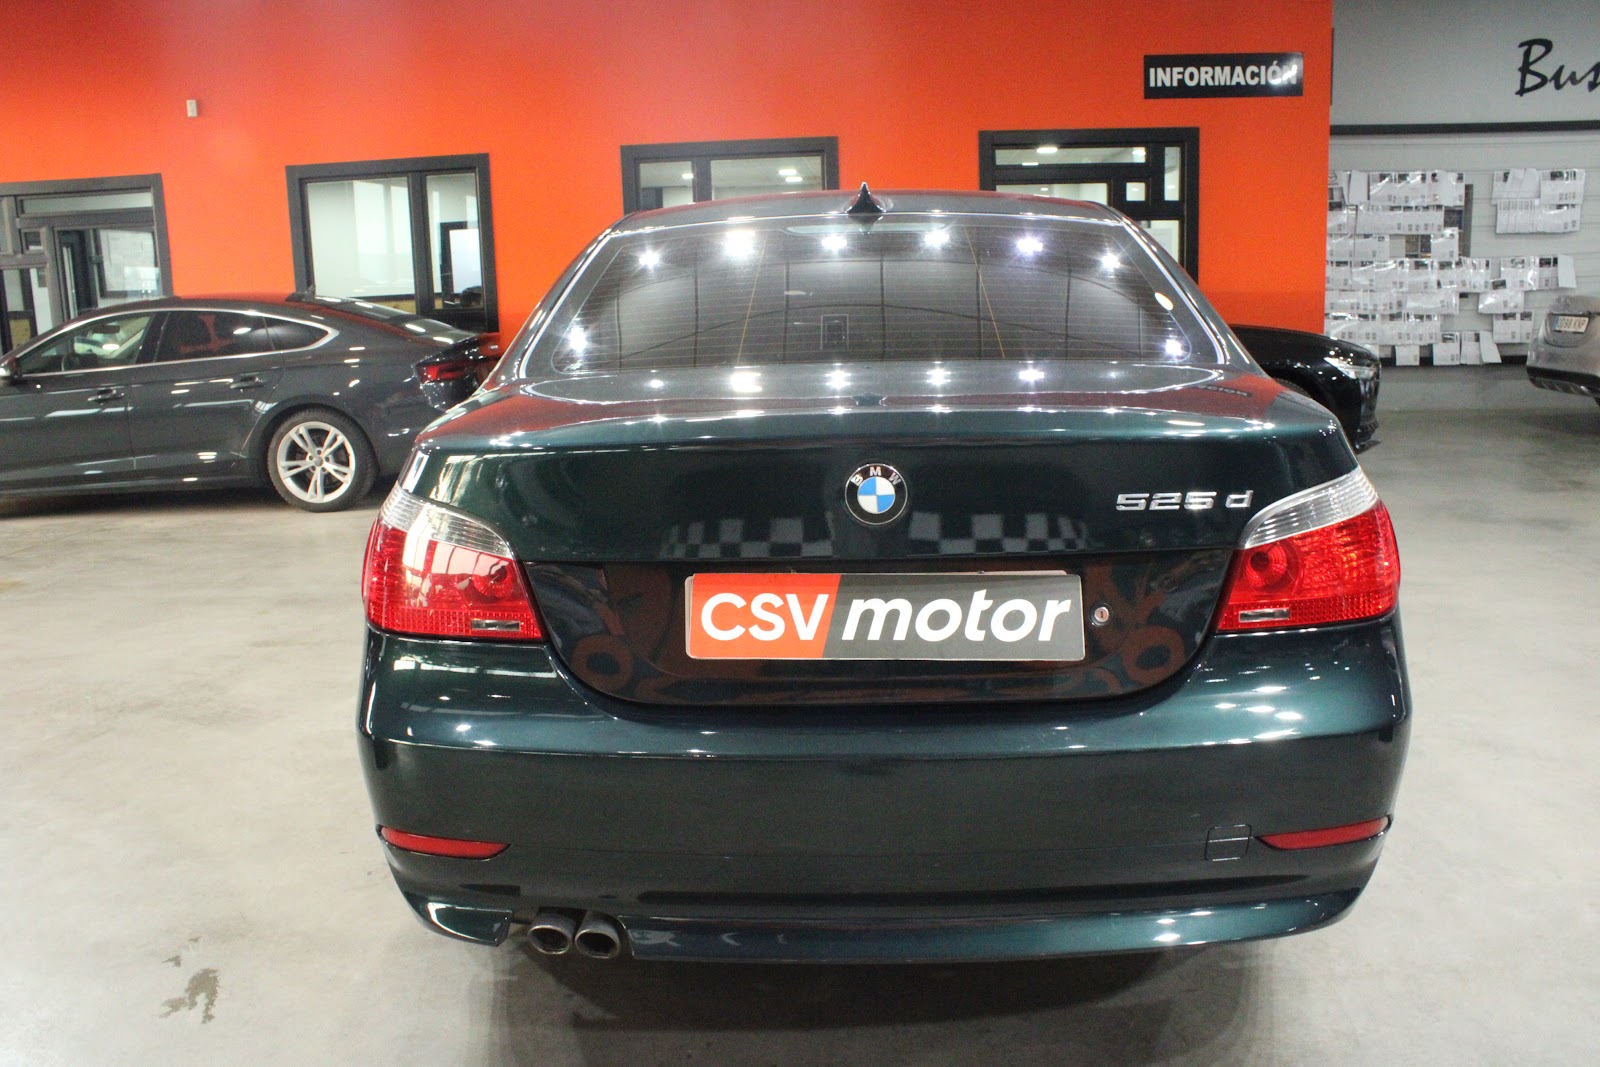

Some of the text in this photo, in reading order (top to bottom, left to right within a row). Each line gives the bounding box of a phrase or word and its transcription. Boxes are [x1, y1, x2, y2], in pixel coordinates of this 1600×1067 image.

[1149, 60, 1298, 88] INFORMACIÓN
[850, 466, 902, 487] BMW
[1115, 489, 1254, 511] 525 d
[701, 588, 1072, 642] CSV motor
